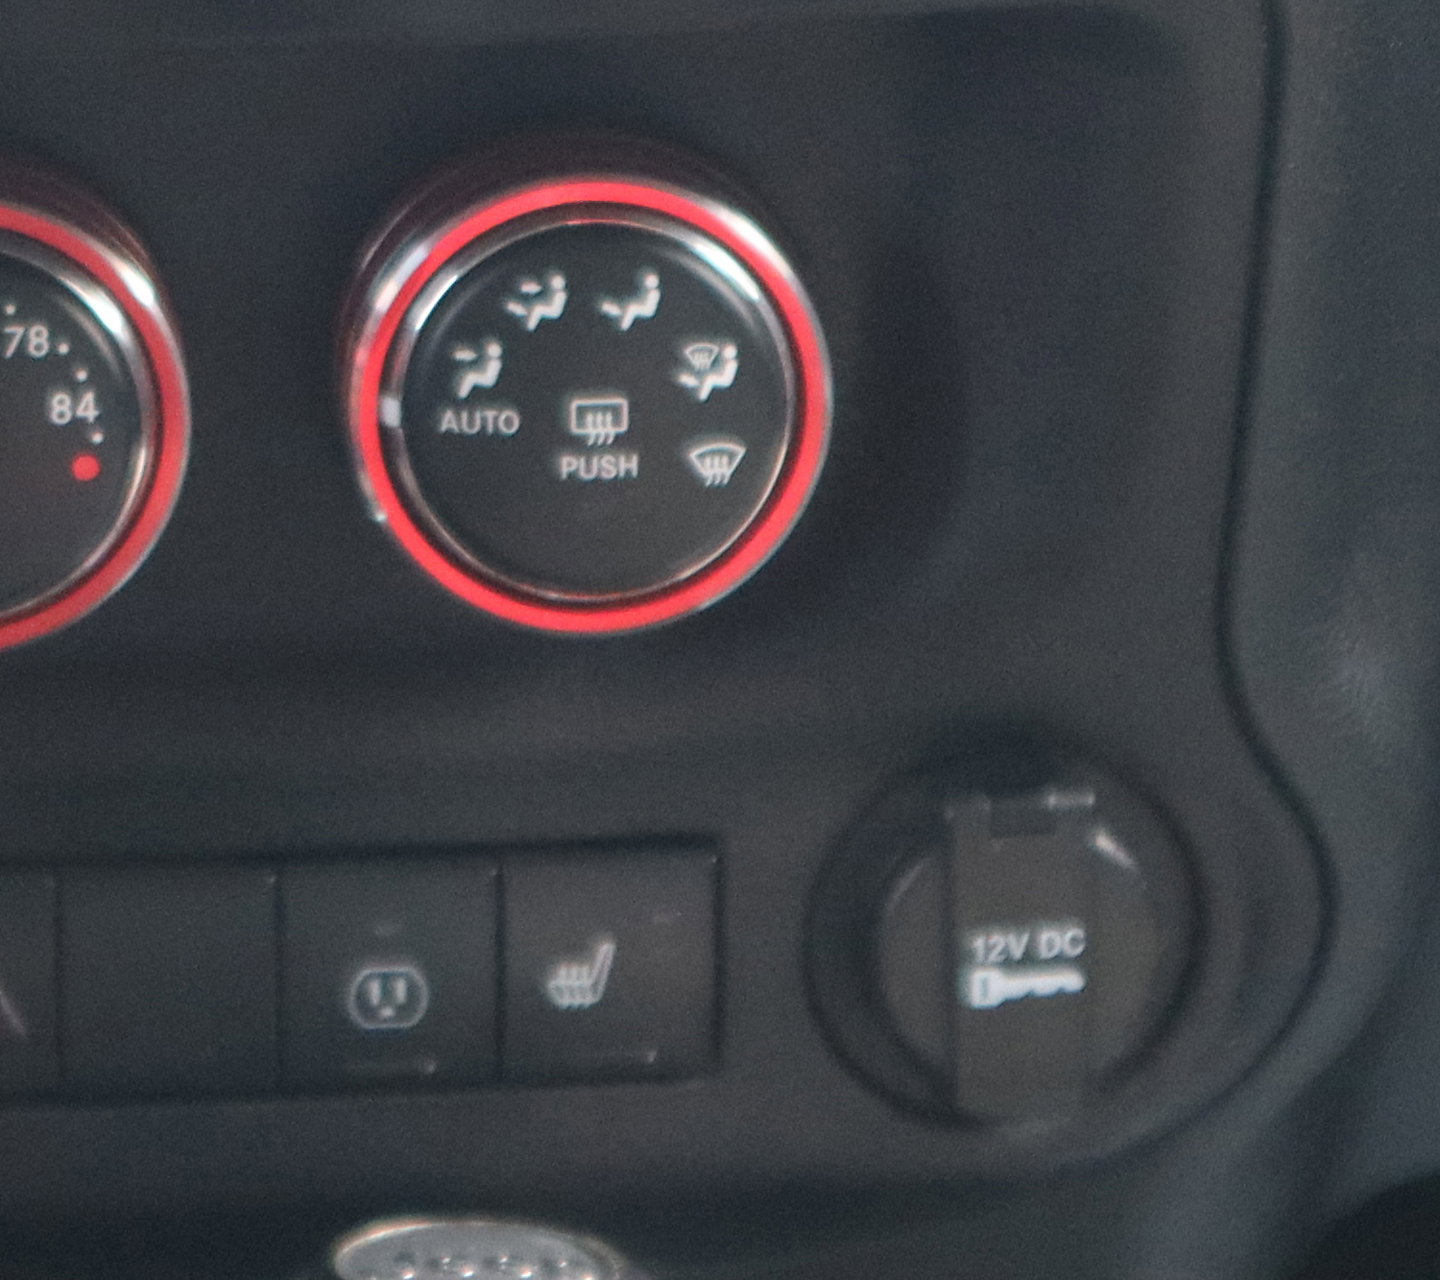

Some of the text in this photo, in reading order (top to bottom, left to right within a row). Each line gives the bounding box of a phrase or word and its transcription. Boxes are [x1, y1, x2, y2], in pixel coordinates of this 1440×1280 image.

[3, 325, 50, 359] 78
[48, 390, 101, 426] 84
[439, 409, 521, 435] AUTO
[558, 455, 639, 481] PUSH
[971, 926, 1086, 962] 12V DC
